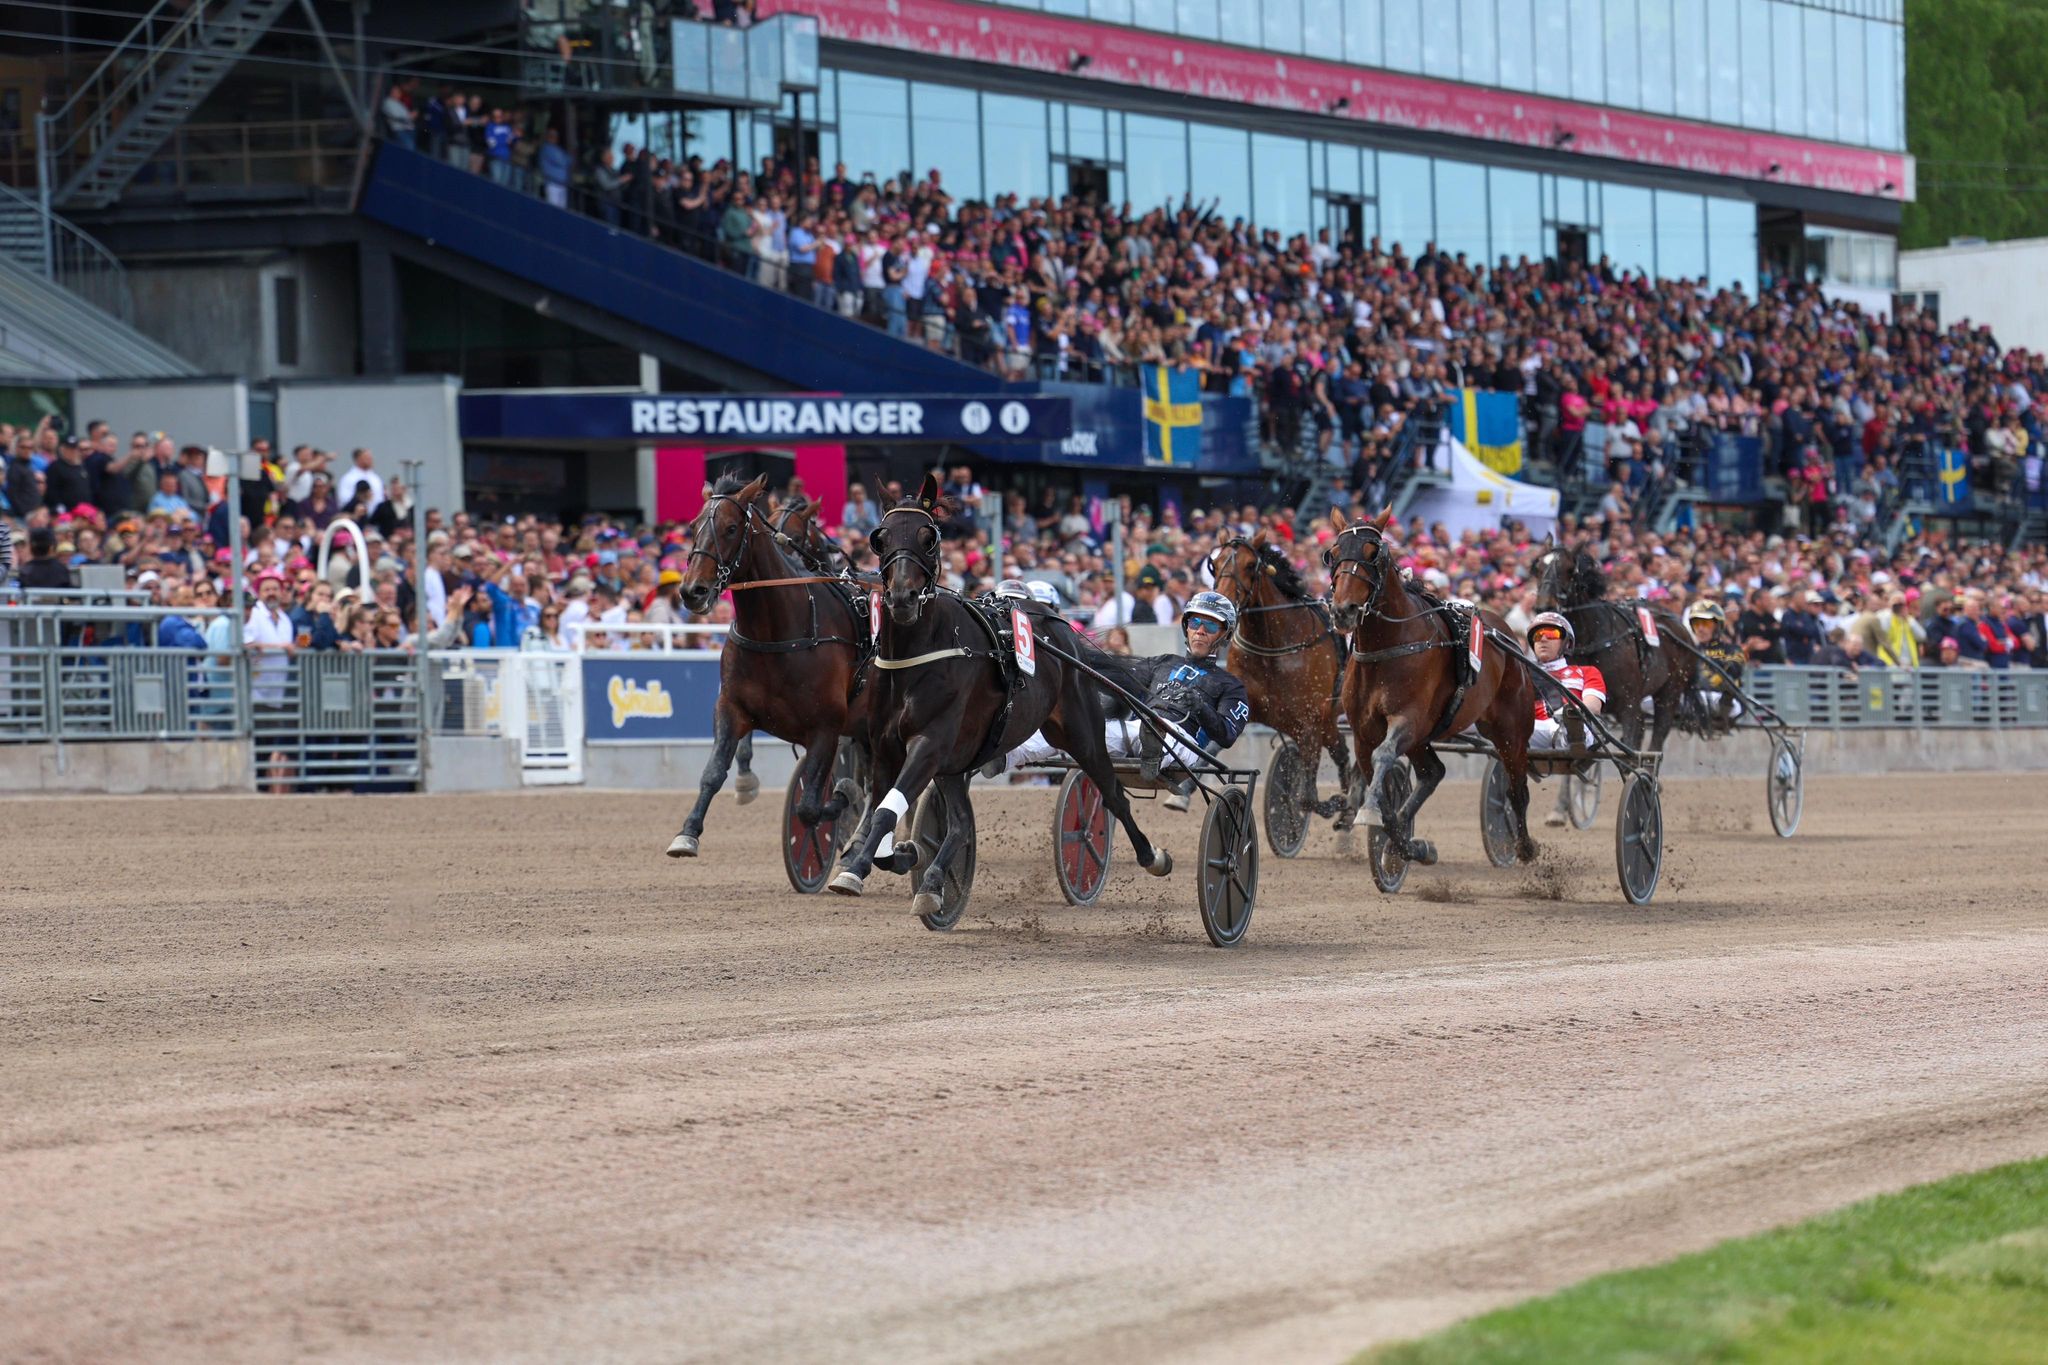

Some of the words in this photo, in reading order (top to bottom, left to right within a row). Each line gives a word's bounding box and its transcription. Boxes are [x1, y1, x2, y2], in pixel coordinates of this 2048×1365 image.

[632, 400, 923, 434] RESTAURANGER
[872, 593, 879, 634] 6
[1016, 611, 1031, 657] 5
[1474, 620, 1480, 656] 1
